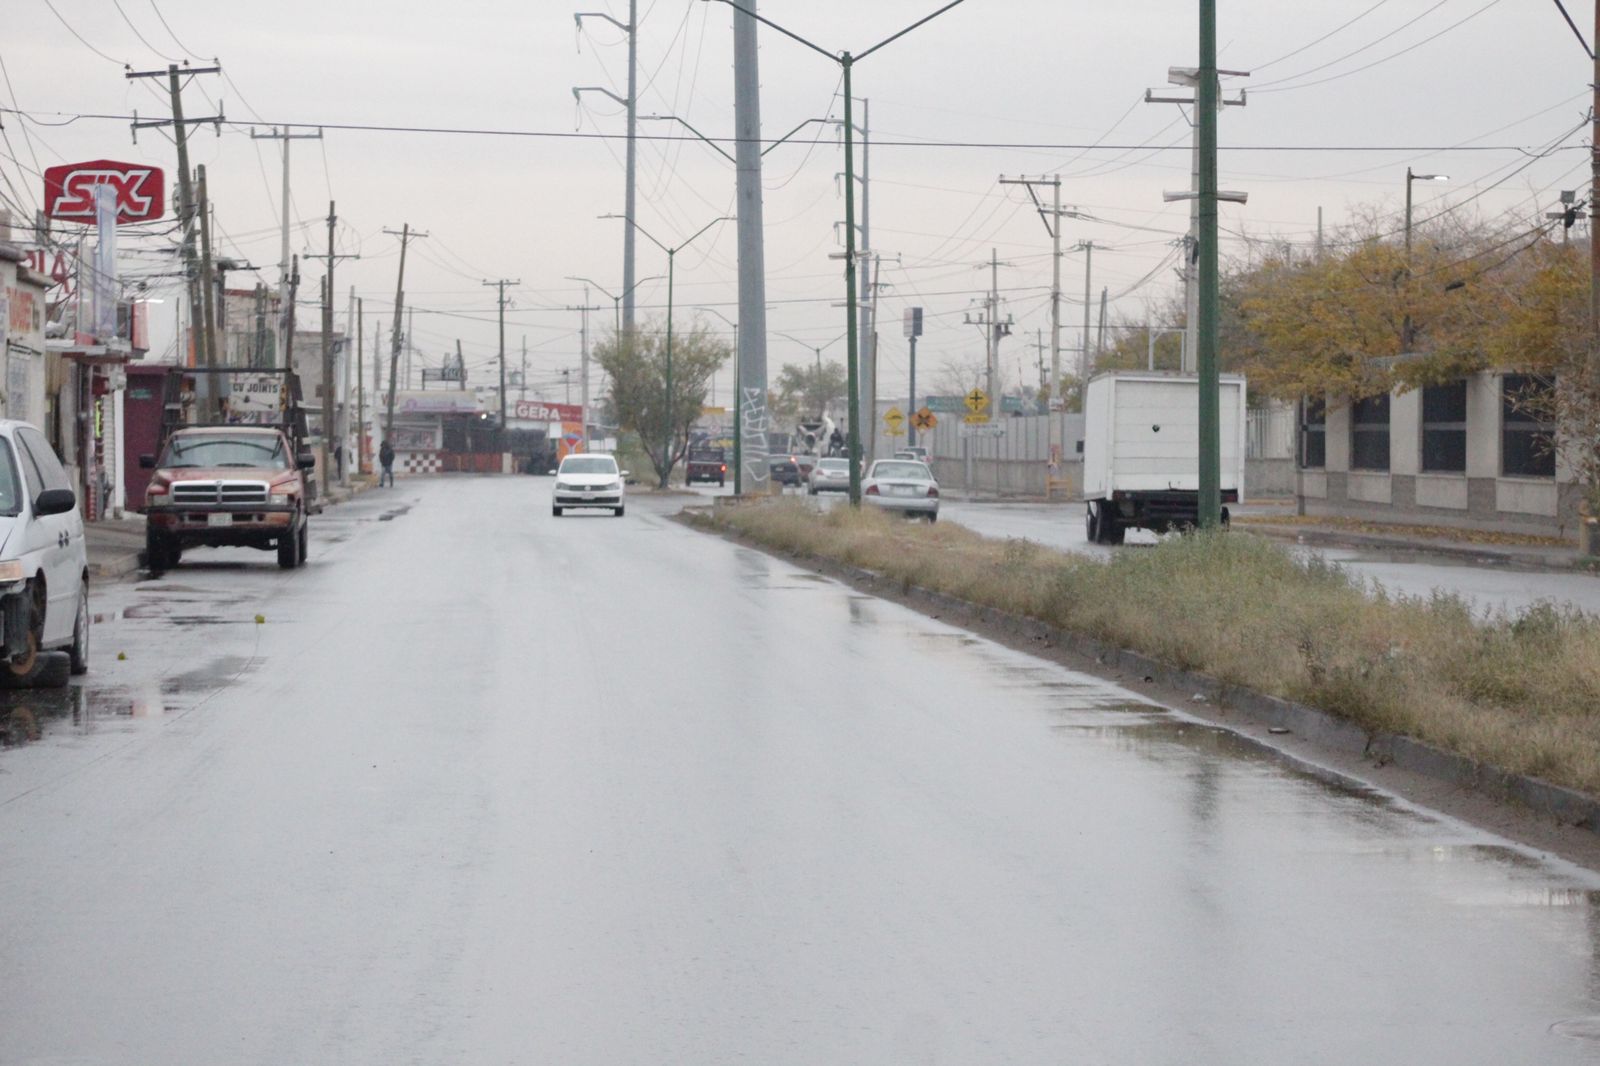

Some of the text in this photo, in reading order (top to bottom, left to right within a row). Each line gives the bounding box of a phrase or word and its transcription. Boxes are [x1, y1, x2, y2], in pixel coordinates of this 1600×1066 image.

[233, 383, 278, 393] CV JOINTS
[516, 405, 560, 420] GERA
